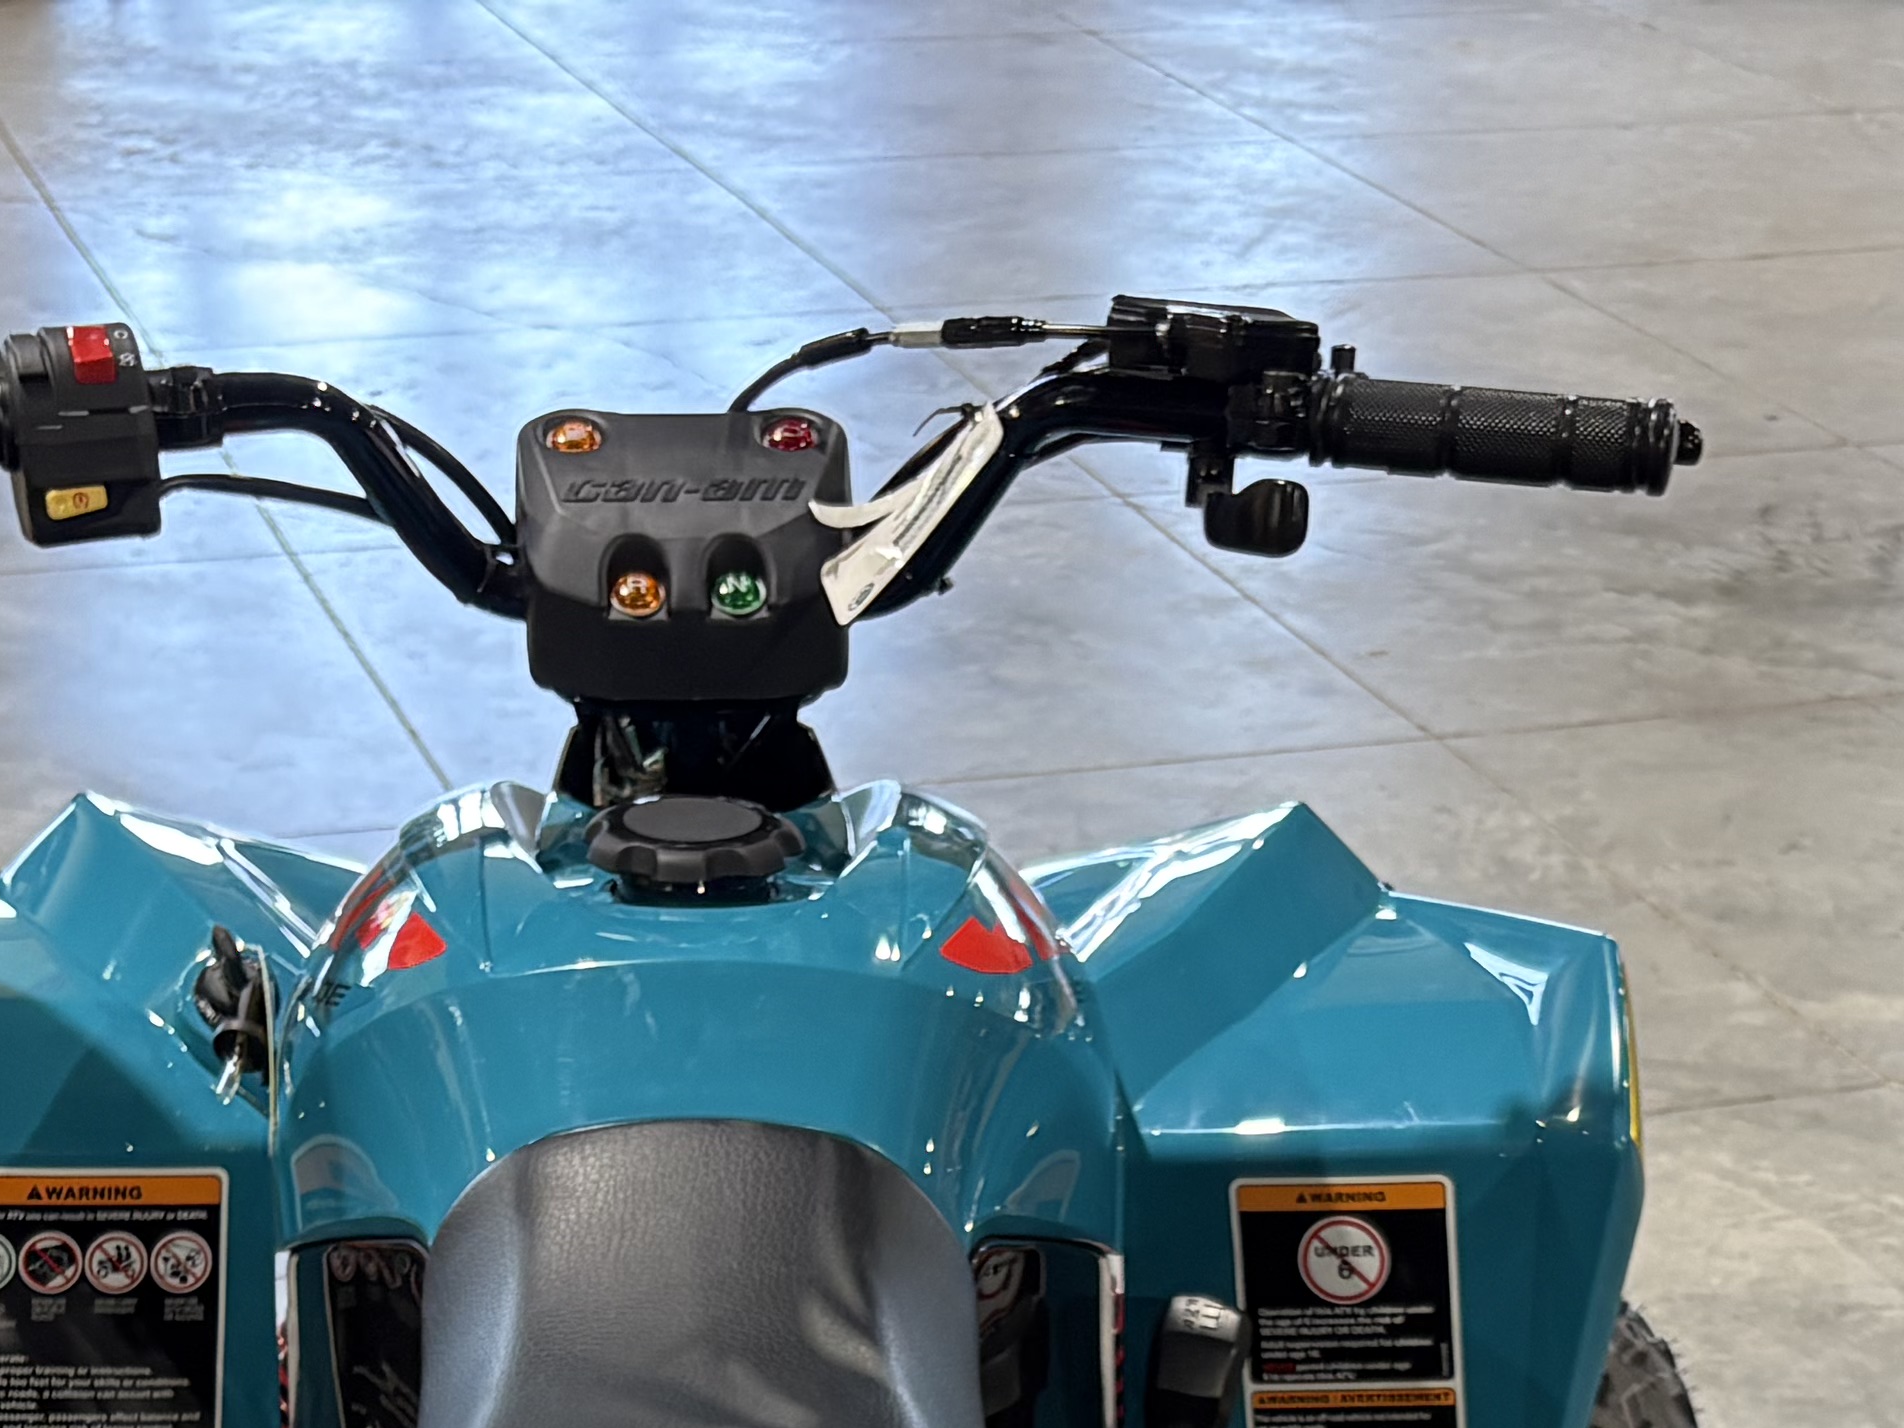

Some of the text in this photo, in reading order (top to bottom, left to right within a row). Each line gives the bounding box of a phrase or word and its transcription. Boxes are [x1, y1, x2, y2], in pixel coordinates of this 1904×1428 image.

[45, 1185, 143, 1201] WARNING
[1310, 1191, 1386, 1204] WARNING
[1314, 1245, 1375, 1258] UNDER
[1338, 1258, 1355, 1280] 6
[35, 1366, 75, 1378] training
[10, 1378, 28, 1388] too
[29, 1377, 49, 1388] fast
[51, 1377, 65, 1388] for
[66, 1379, 91, 1390] your
[96, 1391, 115, 1400] can
[181, 1411, 201, 1422] and
